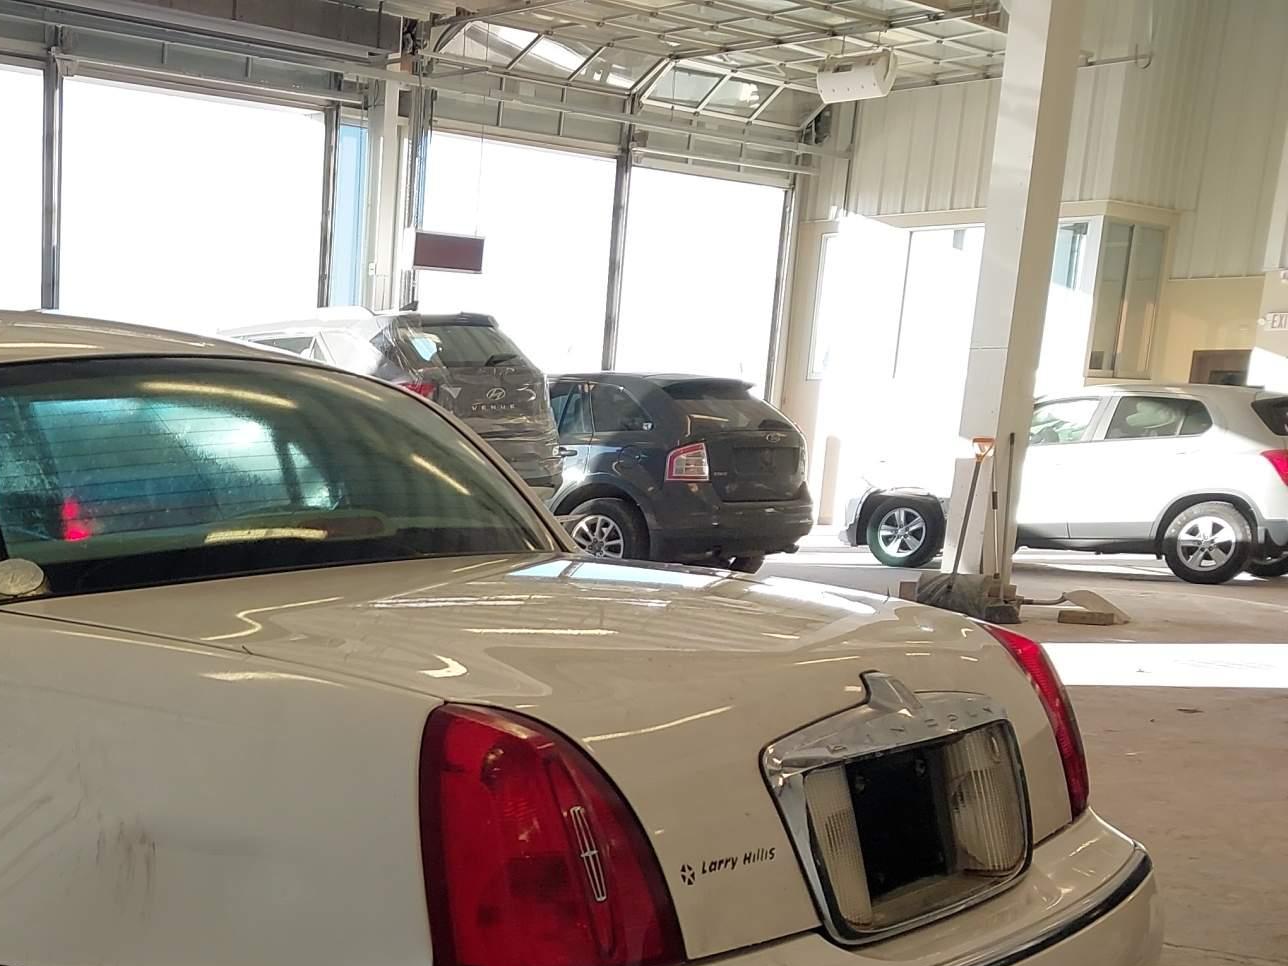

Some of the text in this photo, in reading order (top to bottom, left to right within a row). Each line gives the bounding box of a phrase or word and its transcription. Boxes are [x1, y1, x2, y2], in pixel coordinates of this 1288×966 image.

[1271, 313, 1288, 329] EXI
[701, 847, 776, 875] Larry Hillis
